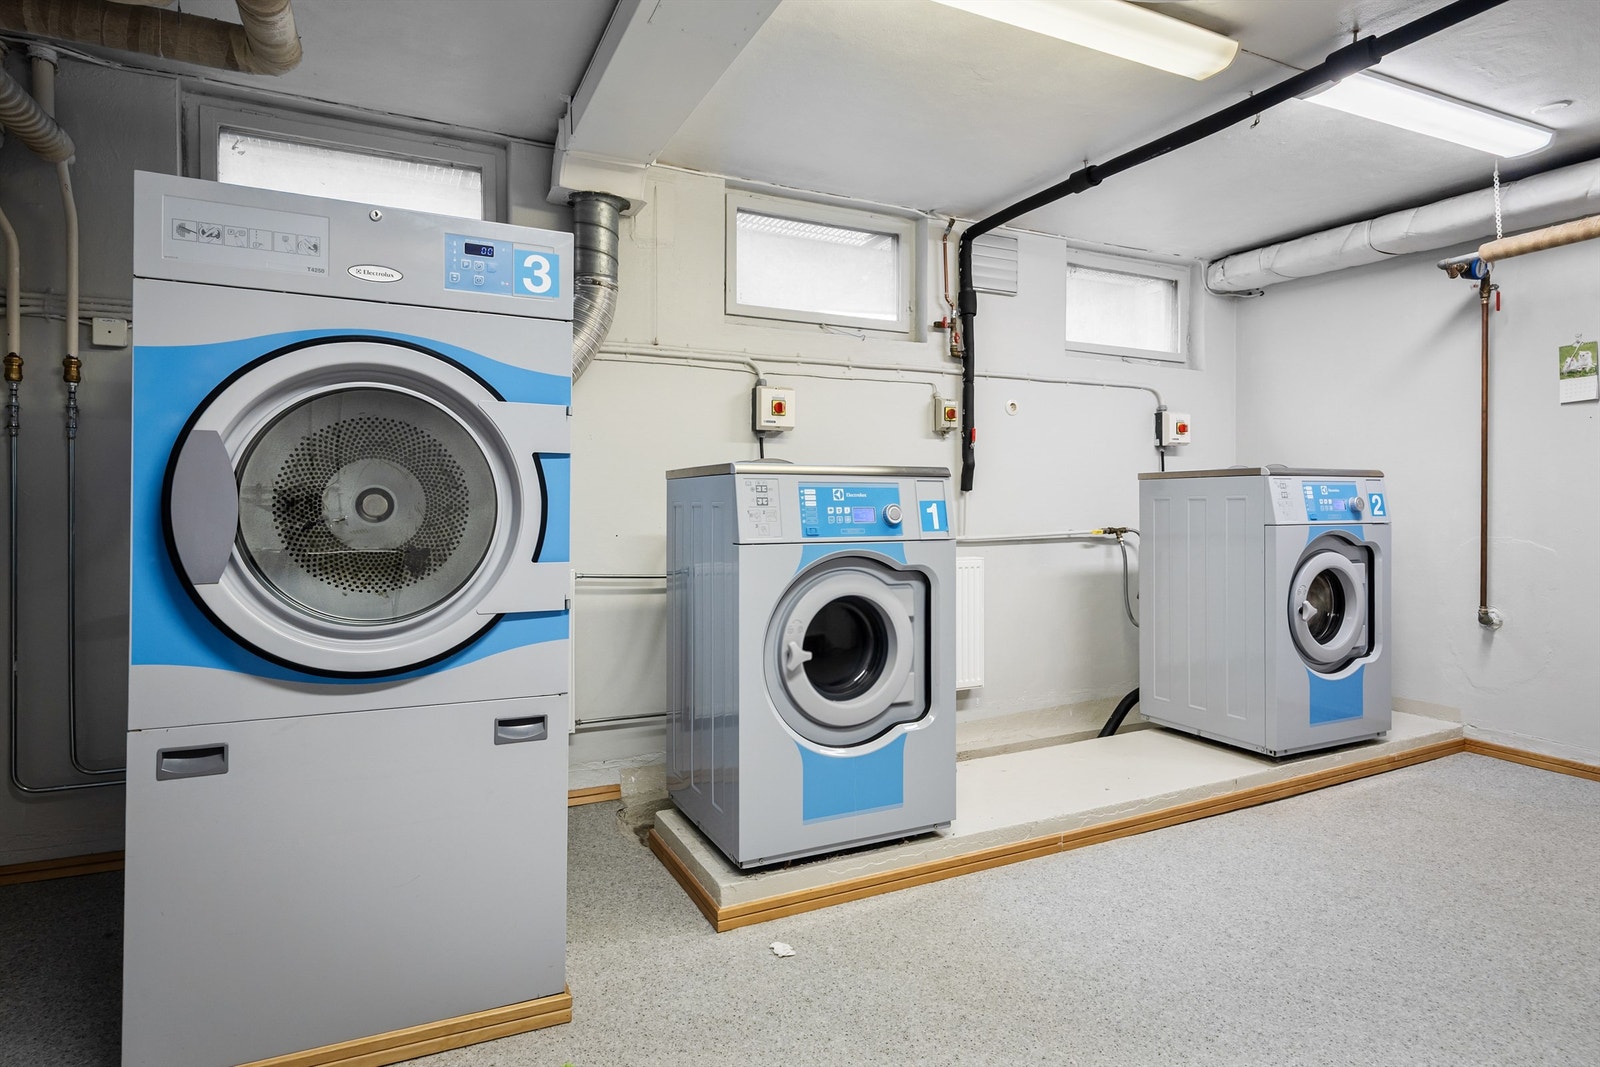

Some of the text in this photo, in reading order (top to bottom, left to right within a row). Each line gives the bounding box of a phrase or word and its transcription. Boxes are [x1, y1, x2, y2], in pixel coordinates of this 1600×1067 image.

[363, 269, 394, 278] Electrolux
[522, 254, 552, 294] 3
[926, 502, 940, 530] 1
[1371, 494, 1384, 515] 2
